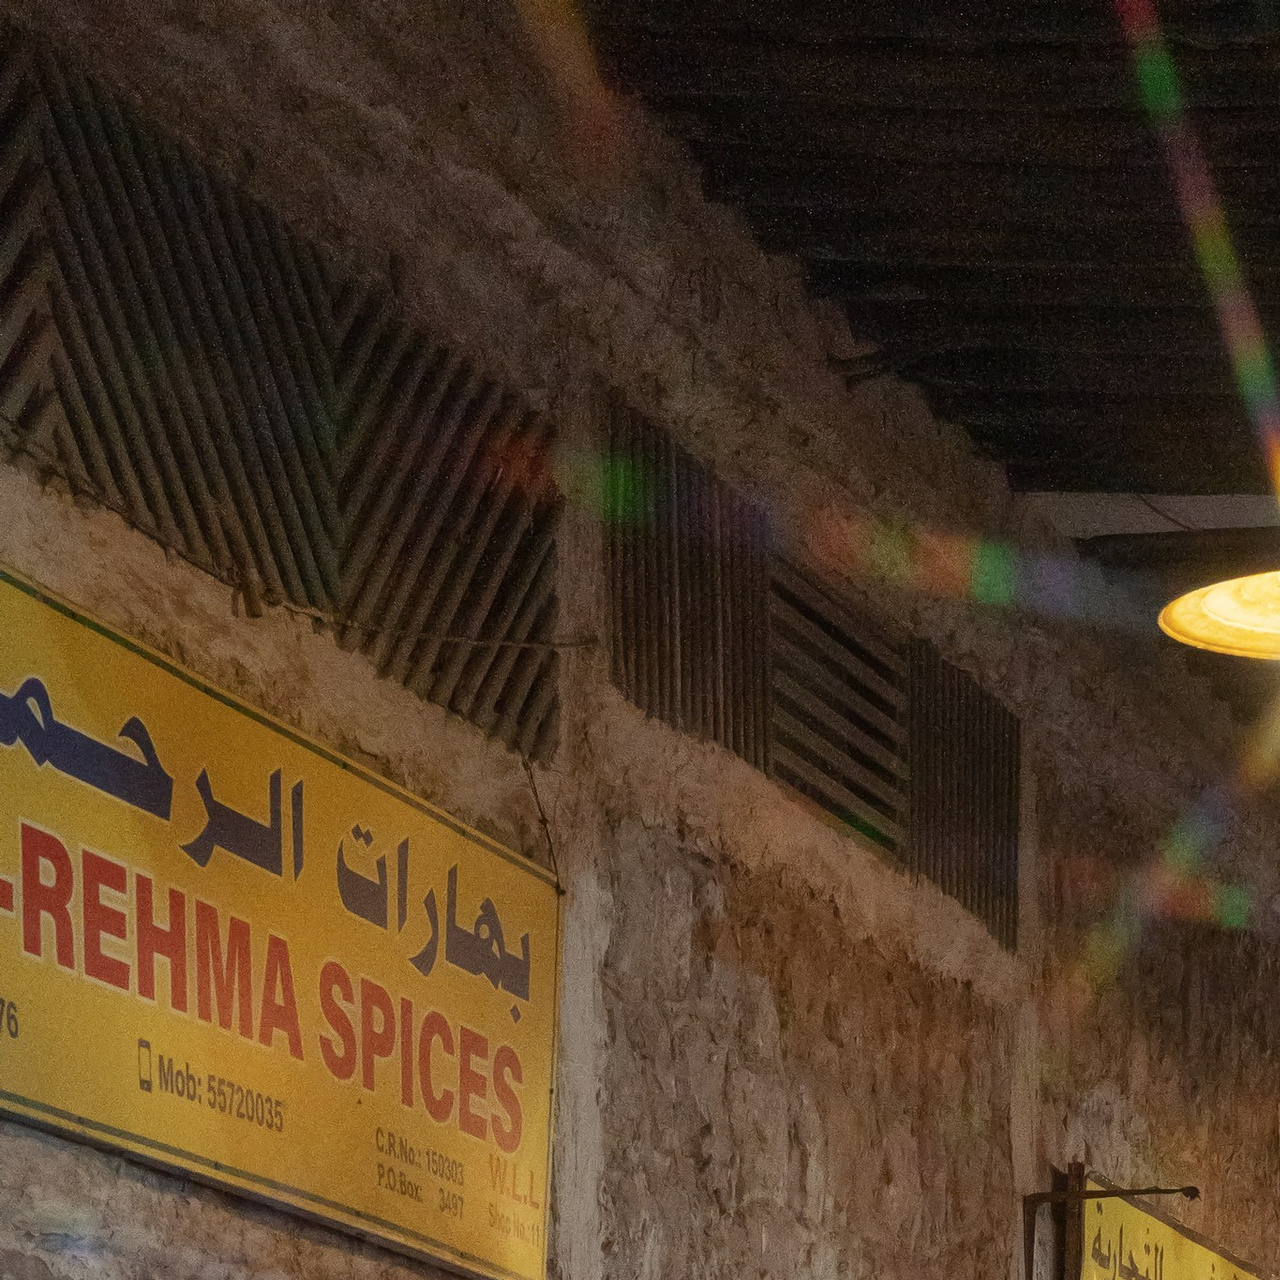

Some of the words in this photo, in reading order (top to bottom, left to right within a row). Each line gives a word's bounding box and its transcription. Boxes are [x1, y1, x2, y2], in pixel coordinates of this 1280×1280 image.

[0, 677, 304, 881] الرحم
[337, 823, 531, 1023] بهارات
[158, 1054, 202, 1105] Mob:
[207, 1074, 284, 1132] 55720035
[318, 960, 524, 1153] SPICES
